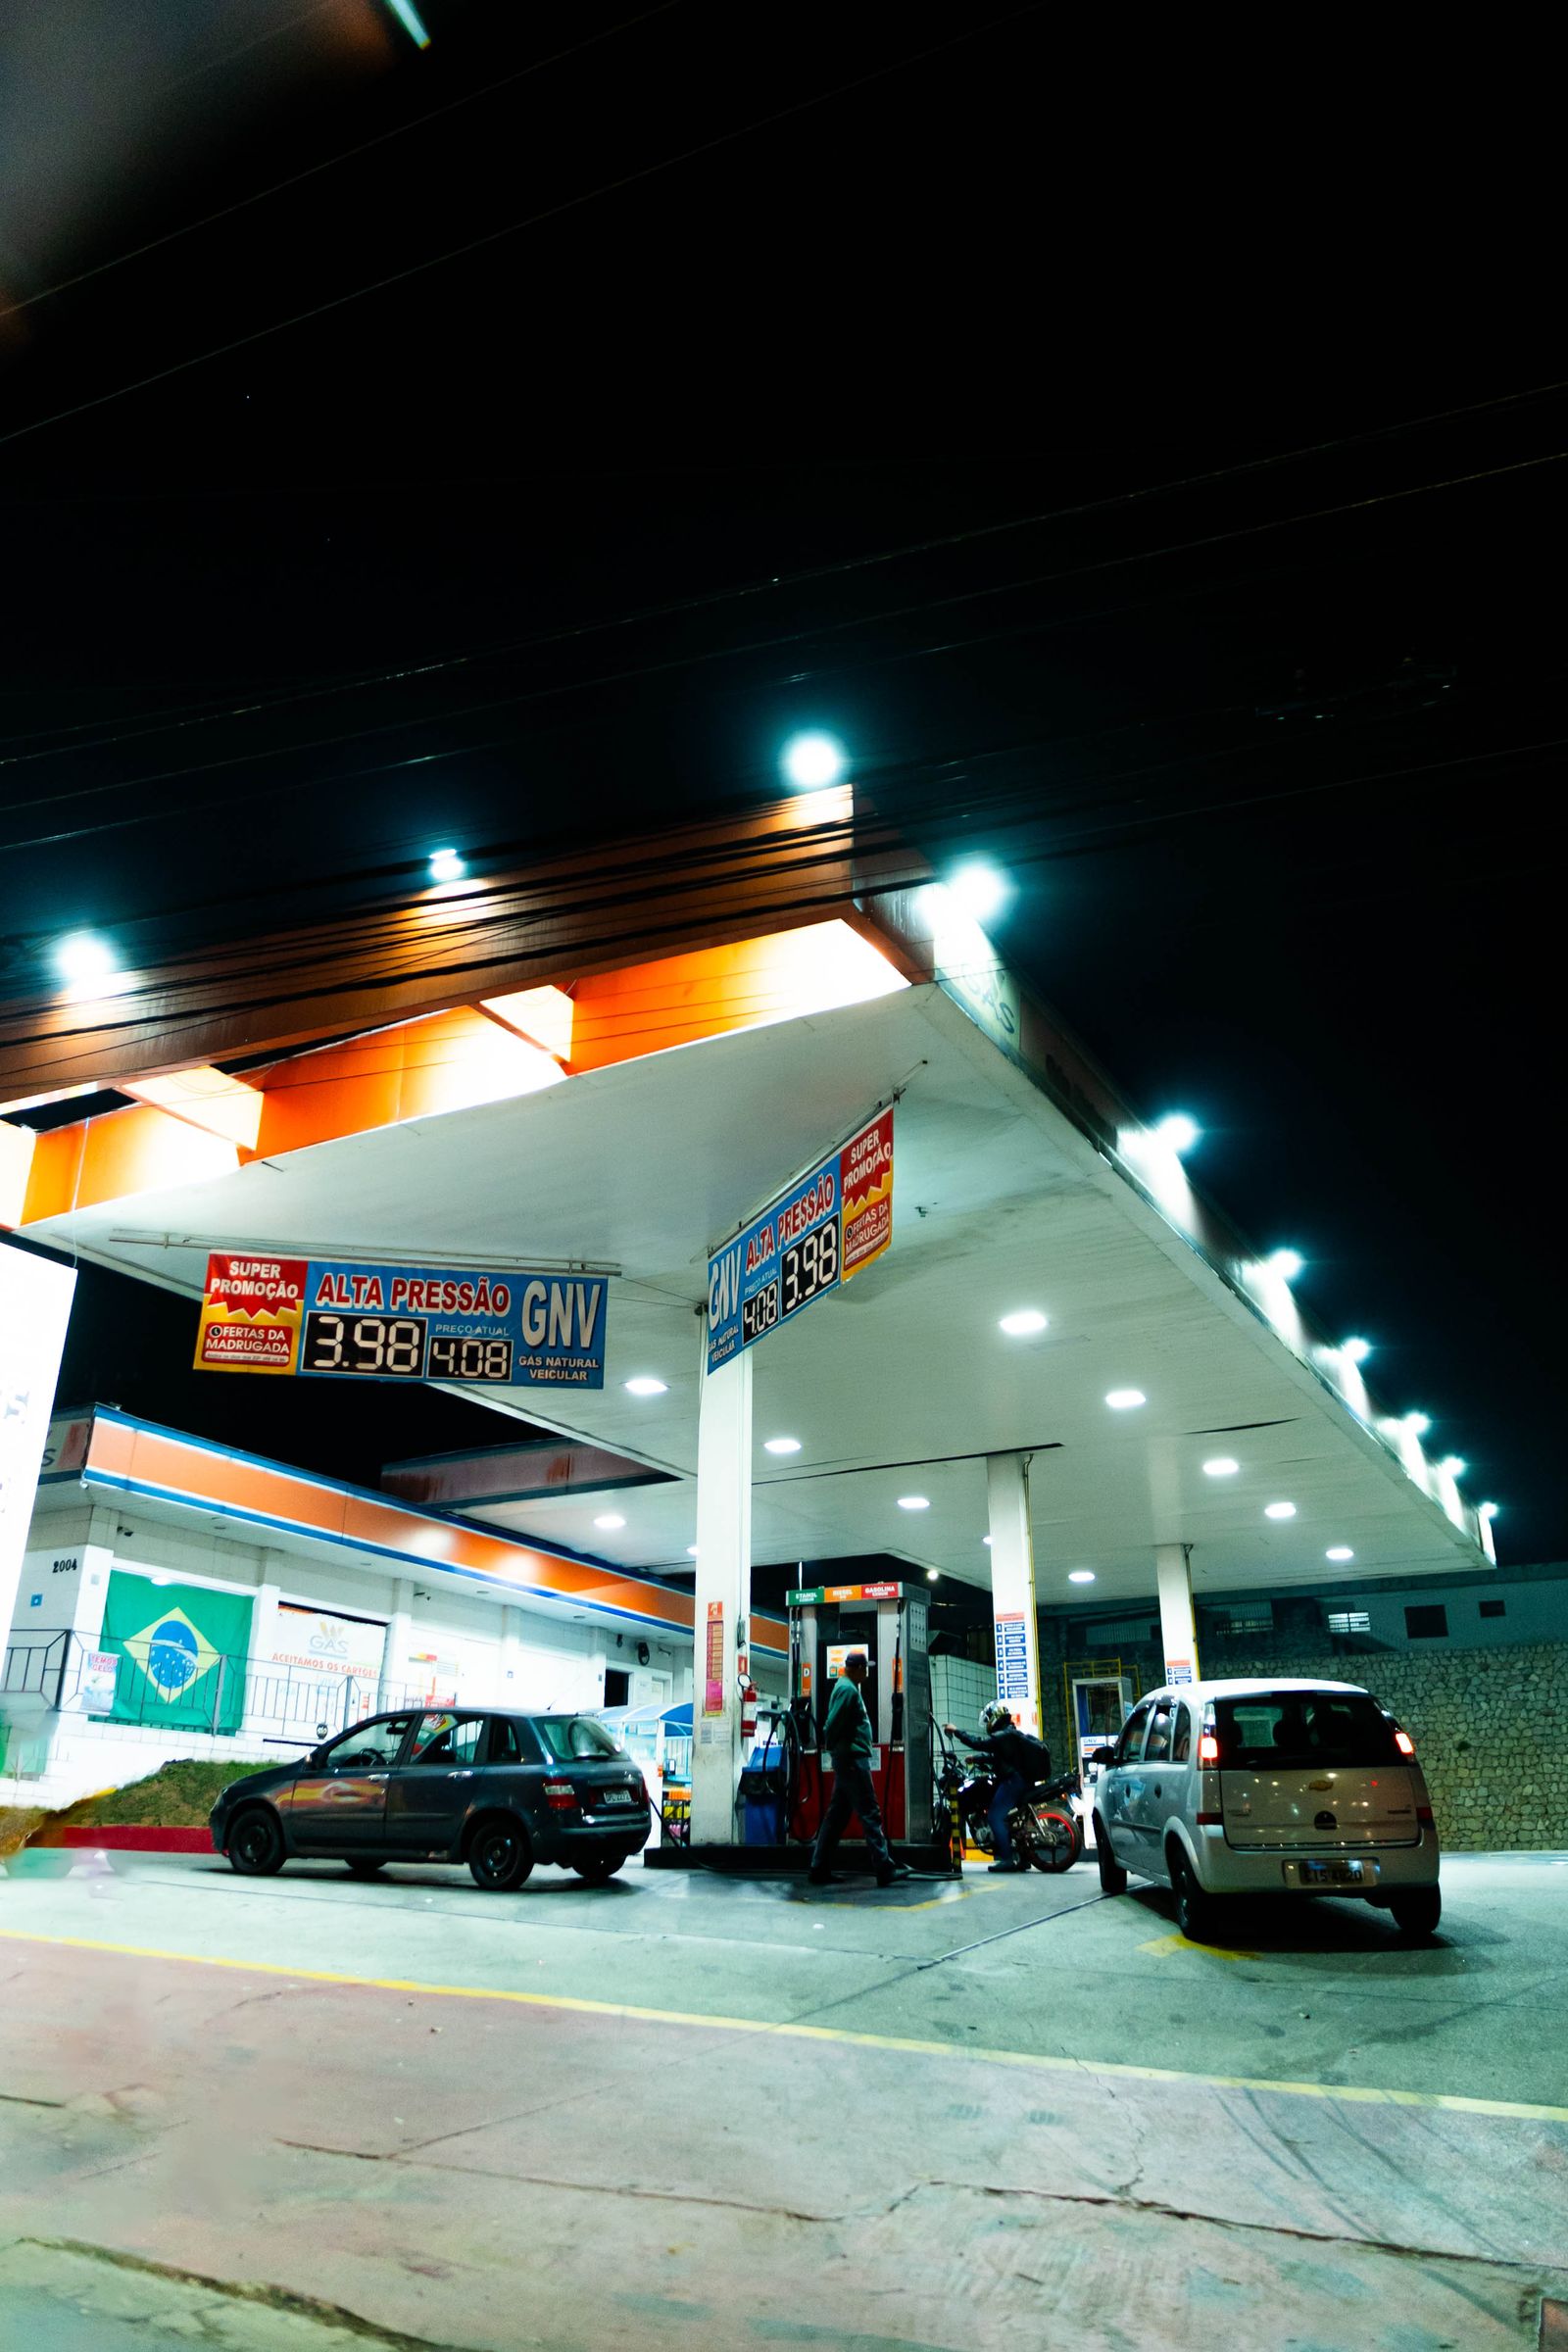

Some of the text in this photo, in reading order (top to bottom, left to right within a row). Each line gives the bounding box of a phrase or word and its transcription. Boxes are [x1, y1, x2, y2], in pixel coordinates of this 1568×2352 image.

[851, 1129, 879, 1164] SUPER
[844, 1142, 891, 1193] PROMOÇÃO
[746, 1223, 775, 1275] ALTA
[777, 1174, 835, 1251] PRESSÃO
[846, 1202, 889, 1240] OFERTAS DA
[846, 1214, 890, 1254] MADRUGADA
[228, 1261, 281, 1279] SUPER
[786, 1222, 836, 1310] 3.98
[210, 1278, 299, 1300] PROMOÇÃO
[316, 1273, 511, 1317] ALTA PRESSÃO
[709, 1245, 742, 1331] GNV
[522, 1280, 602, 1348] GNV
[744, 1282, 778, 1334] 4.08
[206, 1339, 290, 1353] MADRUGADA
[209, 1325, 286, 1341] OFERTAS DA
[314, 1316, 419, 1372] 3.98
[435, 1324, 510, 1337] PREÇO ATUAL
[433, 1341, 508, 1378] 4.08
[529, 1369, 588, 1381] VEICULAR
[546, 1357, 600, 1369] NATURAL
[52, 1558, 77, 1573] 2004
[271, 1652, 324, 1669] ACEITAMOS
[326, 1662, 339, 1672] OS
[309, 1635, 350, 1654] GAS
